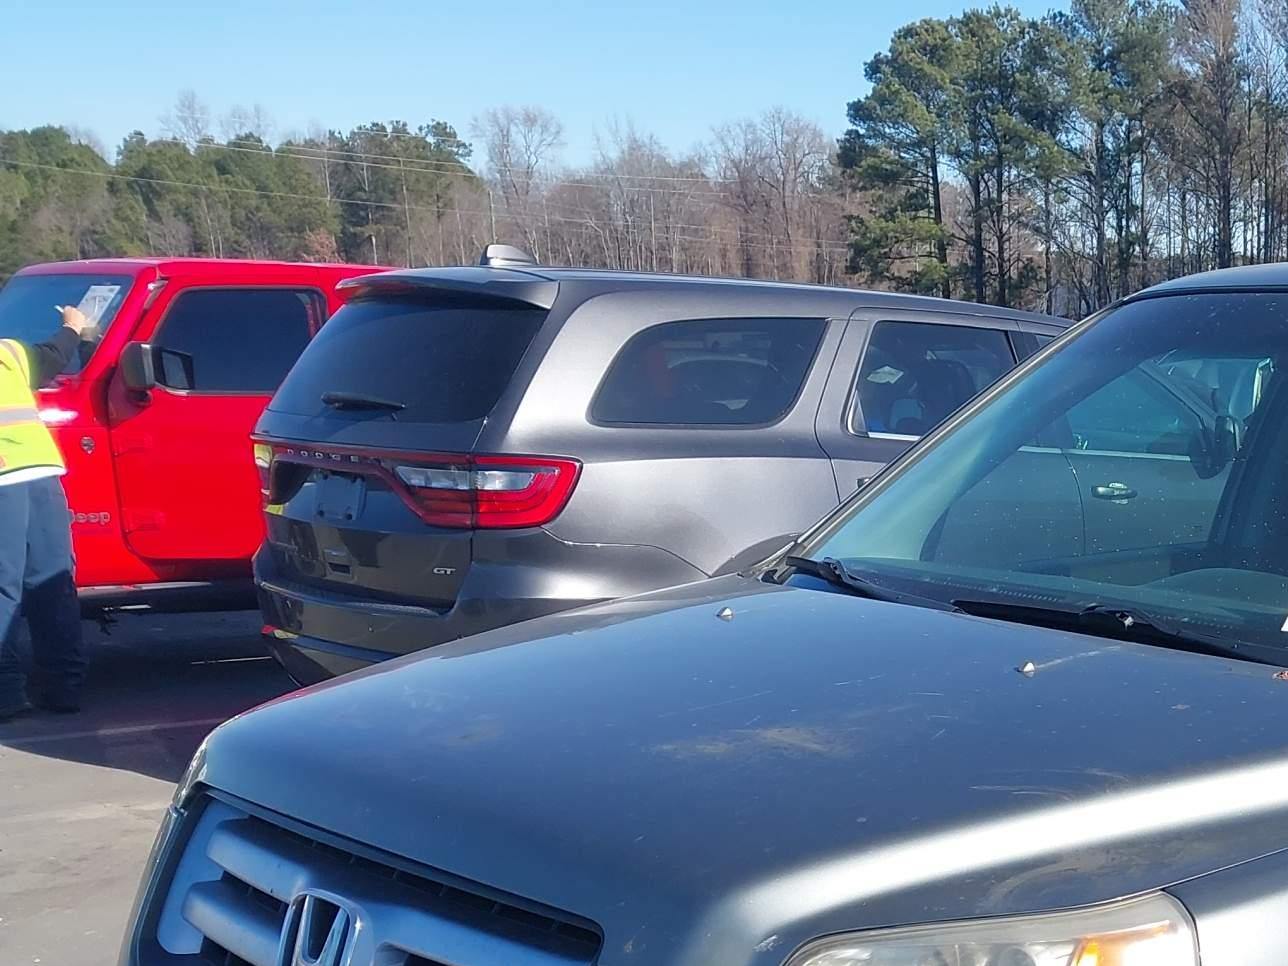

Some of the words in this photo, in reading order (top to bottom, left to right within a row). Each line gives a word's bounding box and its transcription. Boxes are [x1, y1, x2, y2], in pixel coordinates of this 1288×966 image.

[287, 448, 360, 463] DODGE
[74, 511, 111, 526] eep
[433, 567, 456, 575] GT
